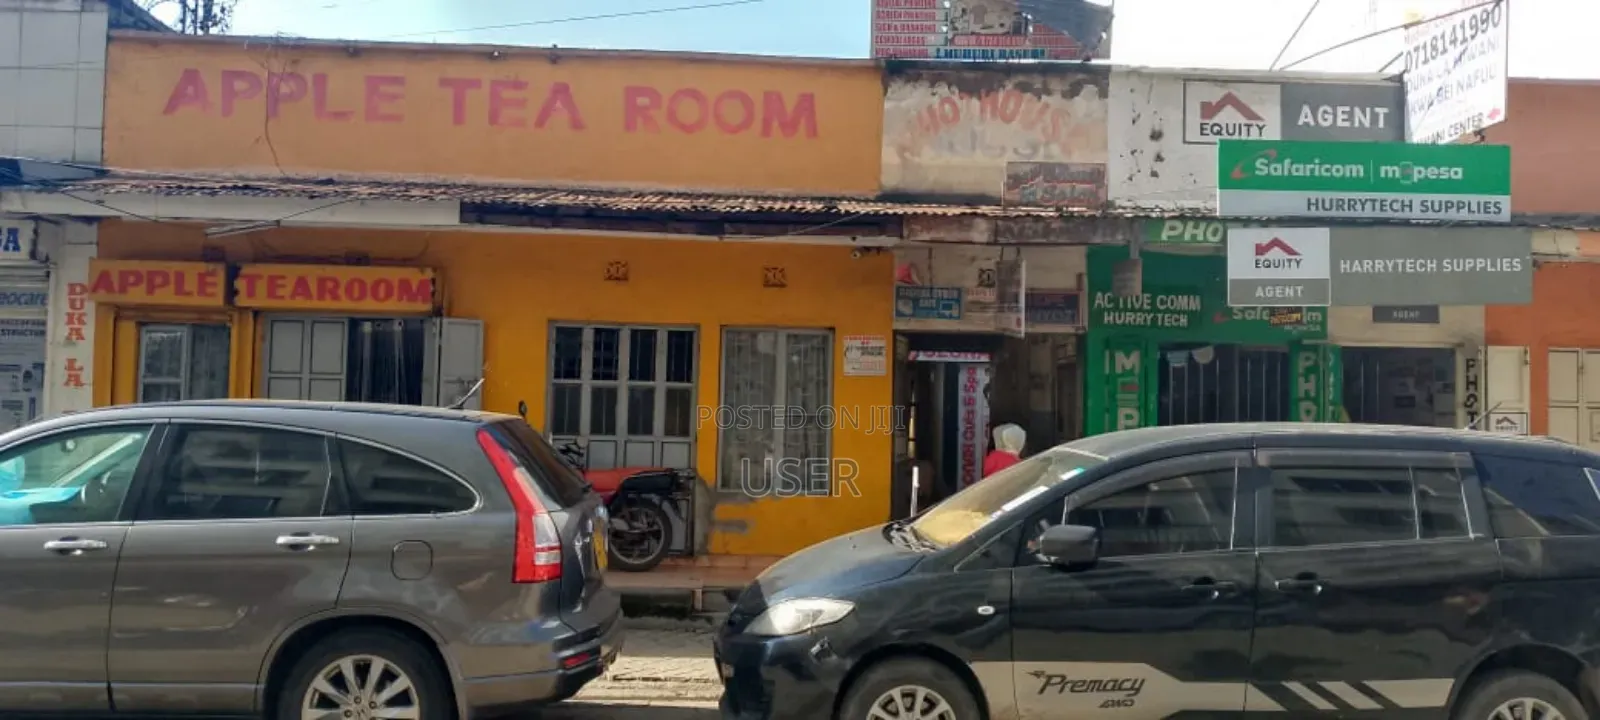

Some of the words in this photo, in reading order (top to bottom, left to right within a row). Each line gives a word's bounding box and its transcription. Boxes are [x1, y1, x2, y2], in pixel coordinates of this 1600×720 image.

[1404, 4, 1501, 74] 0718141990
[162, 68, 406, 124] APPLE
[438, 77, 586, 131] TEA
[623, 85, 819, 139] ROOM
[1298, 105, 1389, 129] AGENT
[1200, 122, 1266, 138] EQUITY
[1255, 152, 1364, 179] Safaricom
[1307, 196, 1413, 213] HURRYTECH
[1420, 199, 1503, 216] SUPPLIES
[0, 227, 21, 252] A
[1254, 258, 1303, 270] EQUITY
[1340, 258, 1437, 274] HARRYTECH
[1443, 257, 1523, 274] SUPPLIES
[89, 268, 218, 299] APPLE
[237, 272, 434, 305] TEAROOM
[1254, 284, 1305, 298] AGENT
[63, 283, 89, 341] DUKA
[1156, 294, 1201, 311] COMM
[1464, 358, 1479, 429] PHOT
[1037, 673, 1146, 698] Premacy
